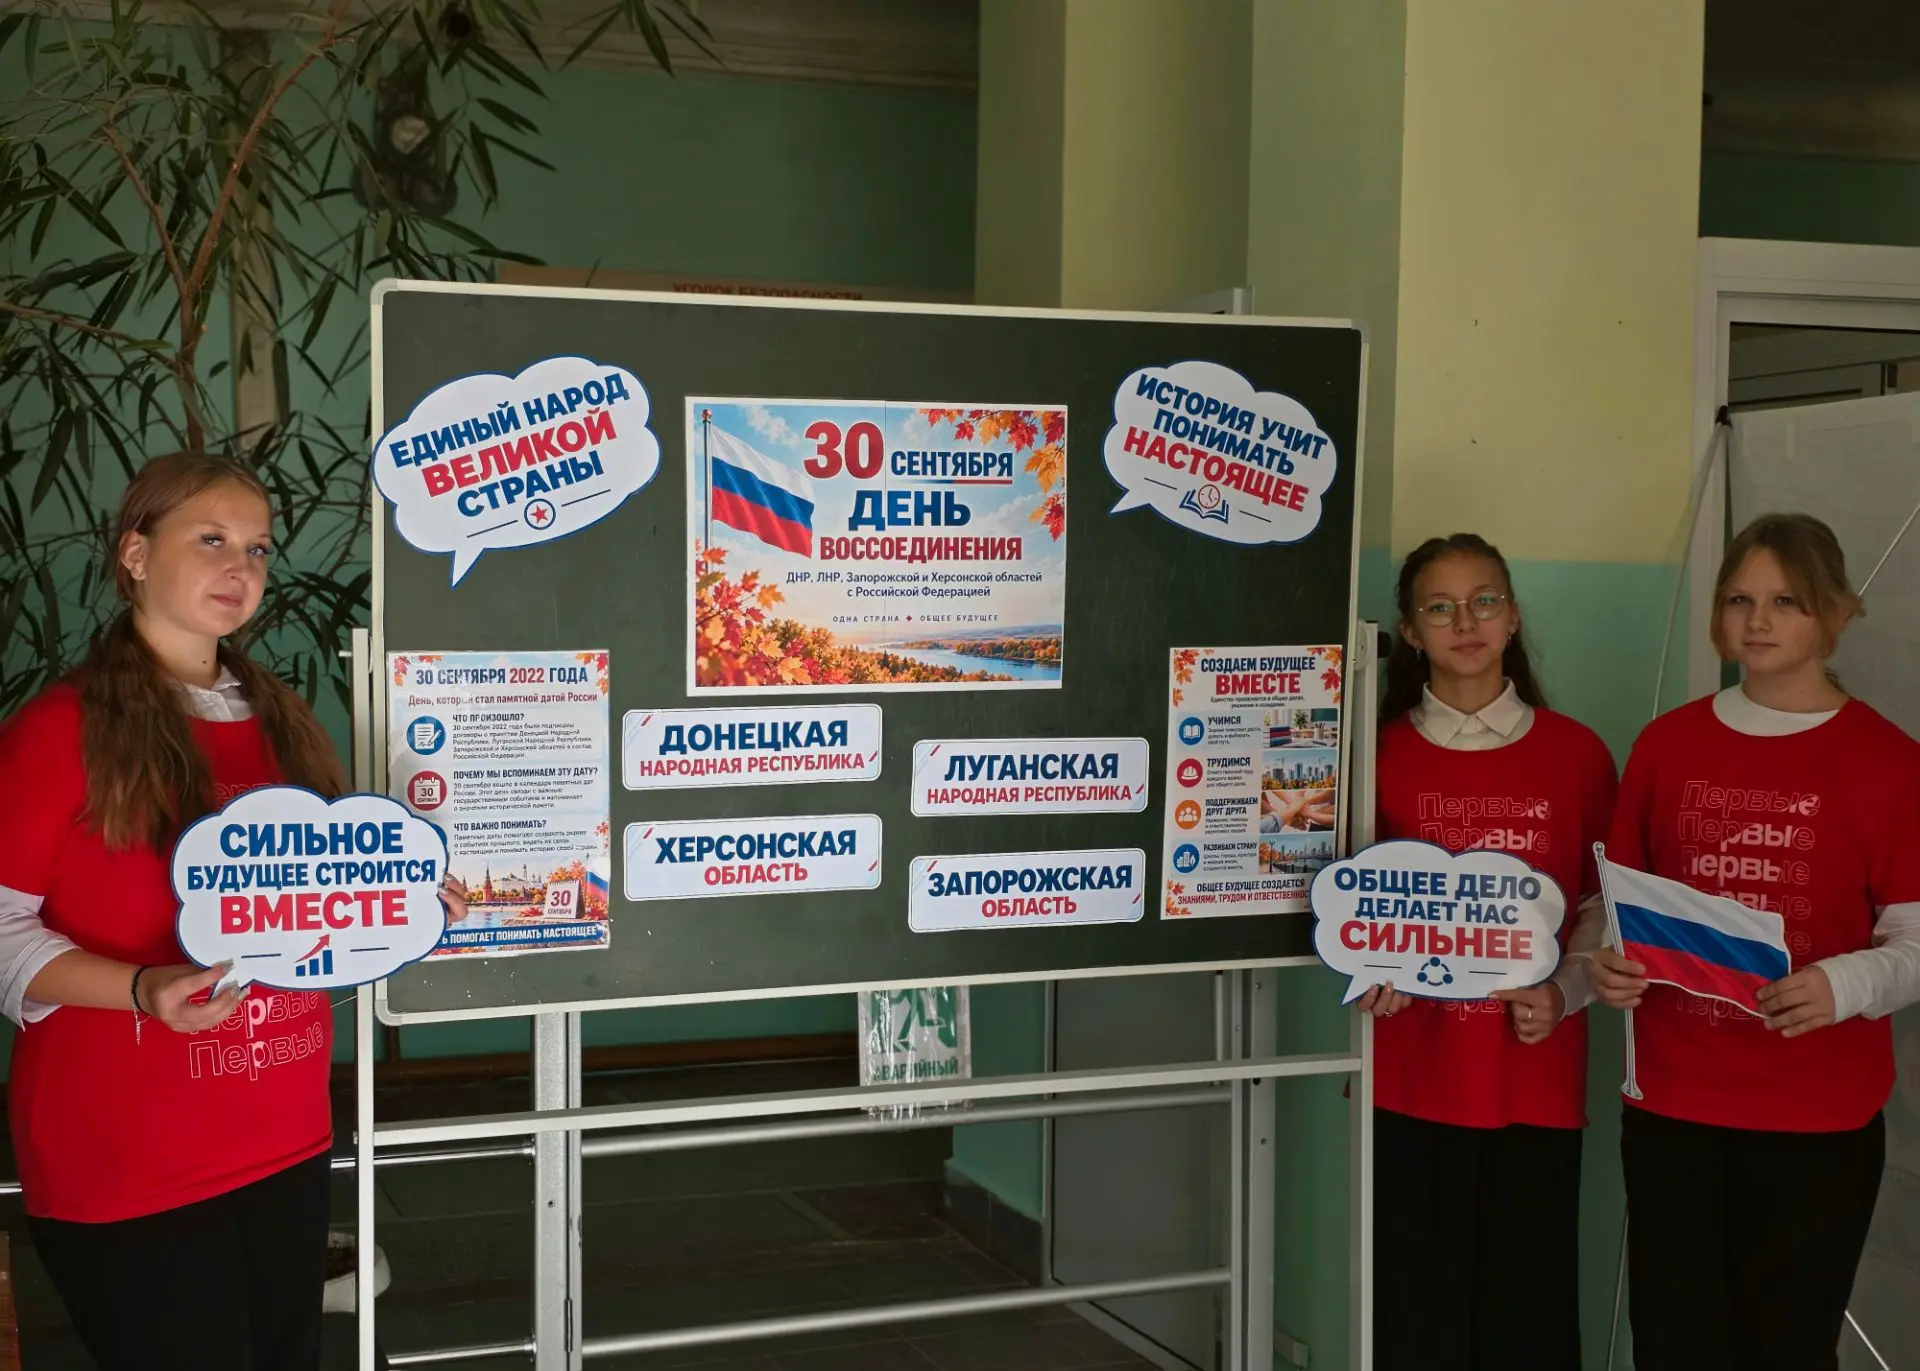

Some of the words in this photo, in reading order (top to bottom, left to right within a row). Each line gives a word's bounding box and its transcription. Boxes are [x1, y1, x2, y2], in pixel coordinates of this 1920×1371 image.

[389, 401, 521, 468] ЕДИНЫЙ
[522, 372, 630, 427] НАРОД
[1136, 373, 1256, 435] ИСТОРИЯ
[1260, 416, 1328, 460] УЧИТ
[421, 407, 618, 498] ВЕЛИКОЙ
[803, 421, 884, 480] 30
[891, 451, 1013, 477] СЕНТЯБРЯ
[1153, 408, 1294, 476] ПОНИМАТЬ
[457, 449, 604, 517] СТРАНЫ
[1123, 426, 1309, 512] НАСТОЯЩЕЕ
[848, 490, 971, 531] ДЕНЬ
[820, 536, 1022, 564] ВОССОЕДИНЕНИЯ
[786, 572, 814, 584] ДНР,
[817, 572, 844, 584] ЛНР,
[846, 571, 919, 584] Запорожской
[922, 573, 929, 582] и
[931, 571, 993, 584] Херсонской
[995, 571, 1043, 583] областей
[847, 589, 853, 597] с
[855, 586, 919, 599] Российской
[921, 586, 991, 599] Федерацией
[832, 615, 858, 623] ОДНА
[863, 614, 900, 623] СТРАНА
[920, 614, 951, 623] ОБЩЕЕ
[956, 614, 998, 623] БУДУЩЕЕ
[416, 669, 433, 685] 30
[438, 668, 505, 685] СЕНТЯБРЯ
[509, 668, 545, 684] 2022
[550, 667, 588, 684] ГОДА
[1201, 656, 1257, 674] СОЗДАЕМ
[1259, 656, 1316, 673] БУДУЩЕЕ
[1215, 673, 1301, 696] ВМЕСТЕ
[408, 695, 434, 707] День,
[475, 694, 495, 703] стал
[496, 693, 538, 703] памятной
[540, 693, 566, 704] датой
[568, 692, 598, 702] России
[453, 714, 468, 722] ЧТО
[1208, 716, 1241, 725] УЧИМСЯ
[659, 720, 848, 756] ДОНЕЦКАЯ
[453, 770, 485, 780] ПОЧЕМУ
[486, 770, 500, 778] МЫ
[502, 768, 556, 778] ВСПОМИНАЕМ
[557, 768, 572, 776] ЭТУ
[573, 767, 598, 777] ДАТУ?
[640, 755, 742, 777] НАРОДНАЯ
[747, 753, 865, 774] РЕСПУБЛИКА
[944, 753, 1119, 783] ЛУГАНСКАЯ
[1207, 757, 1251, 768] ТРУДИМСЯ
[421, 787, 433, 797] 30
[927, 787, 1020, 805] НАРОДНАЯ
[1024, 785, 1132, 804] РЕСПУБЛИКА
[1681, 780, 1821, 818] Первые
[1206, 807, 1224, 816] ДРУГ
[1225, 806, 1247, 816] ДРУГА
[1419, 793, 1551, 825] Первые
[454, 823, 469, 831] ЧТО
[471, 821, 499, 831] ВАЖНО
[501, 819, 547, 829] ПОНИМАТЬ?
[1678, 812, 1815, 852] Первые
[220, 821, 404, 858] СИЛЬНОЕ
[655, 829, 857, 864] ХЕРСОНСКАЯ
[187, 862, 309, 893] БУДУЩЕЕ
[315, 859, 436, 886] СТРОИТСЯ
[703, 862, 808, 887] ОБЛАСТЬ
[1682, 845, 1811, 887] Первые
[928, 864, 1132, 897] ЗАПОРОЖСКАЯ
[1197, 883, 1223, 893] ОБЩЕЕ
[1225, 881, 1260, 892] БУДУЩЕЕ
[1261, 878, 1305, 890] СОЗДАЕТСЯ
[1334, 867, 1447, 898] ОБЩЕЕ
[1454, 873, 1542, 901] ДЕЛО
[220, 889, 408, 935] ВМЕСТЕ
[550, 890, 572, 907] 30
[981, 896, 1077, 919] ОБЛАСТЬ
[1178, 895, 1217, 905] ЗНАНИЯМИ,
[1219, 892, 1247, 903] ТРУДОМ
[1248, 892, 1253, 901] И
[1355, 897, 1458, 921] ДЕЛАЕТ
[1465, 903, 1519, 925] НАС
[450, 929, 494, 944] ПОМОГАЕТ
[496, 927, 542, 942] ПОНИМАТЬ
[543, 925, 598, 939] НАСТОЯЩЕЕ
[1339, 920, 1533, 960] СИЛЬНЕЕ
[190, 989, 320, 1039] ервые
[189, 1020, 325, 1082] Первые
